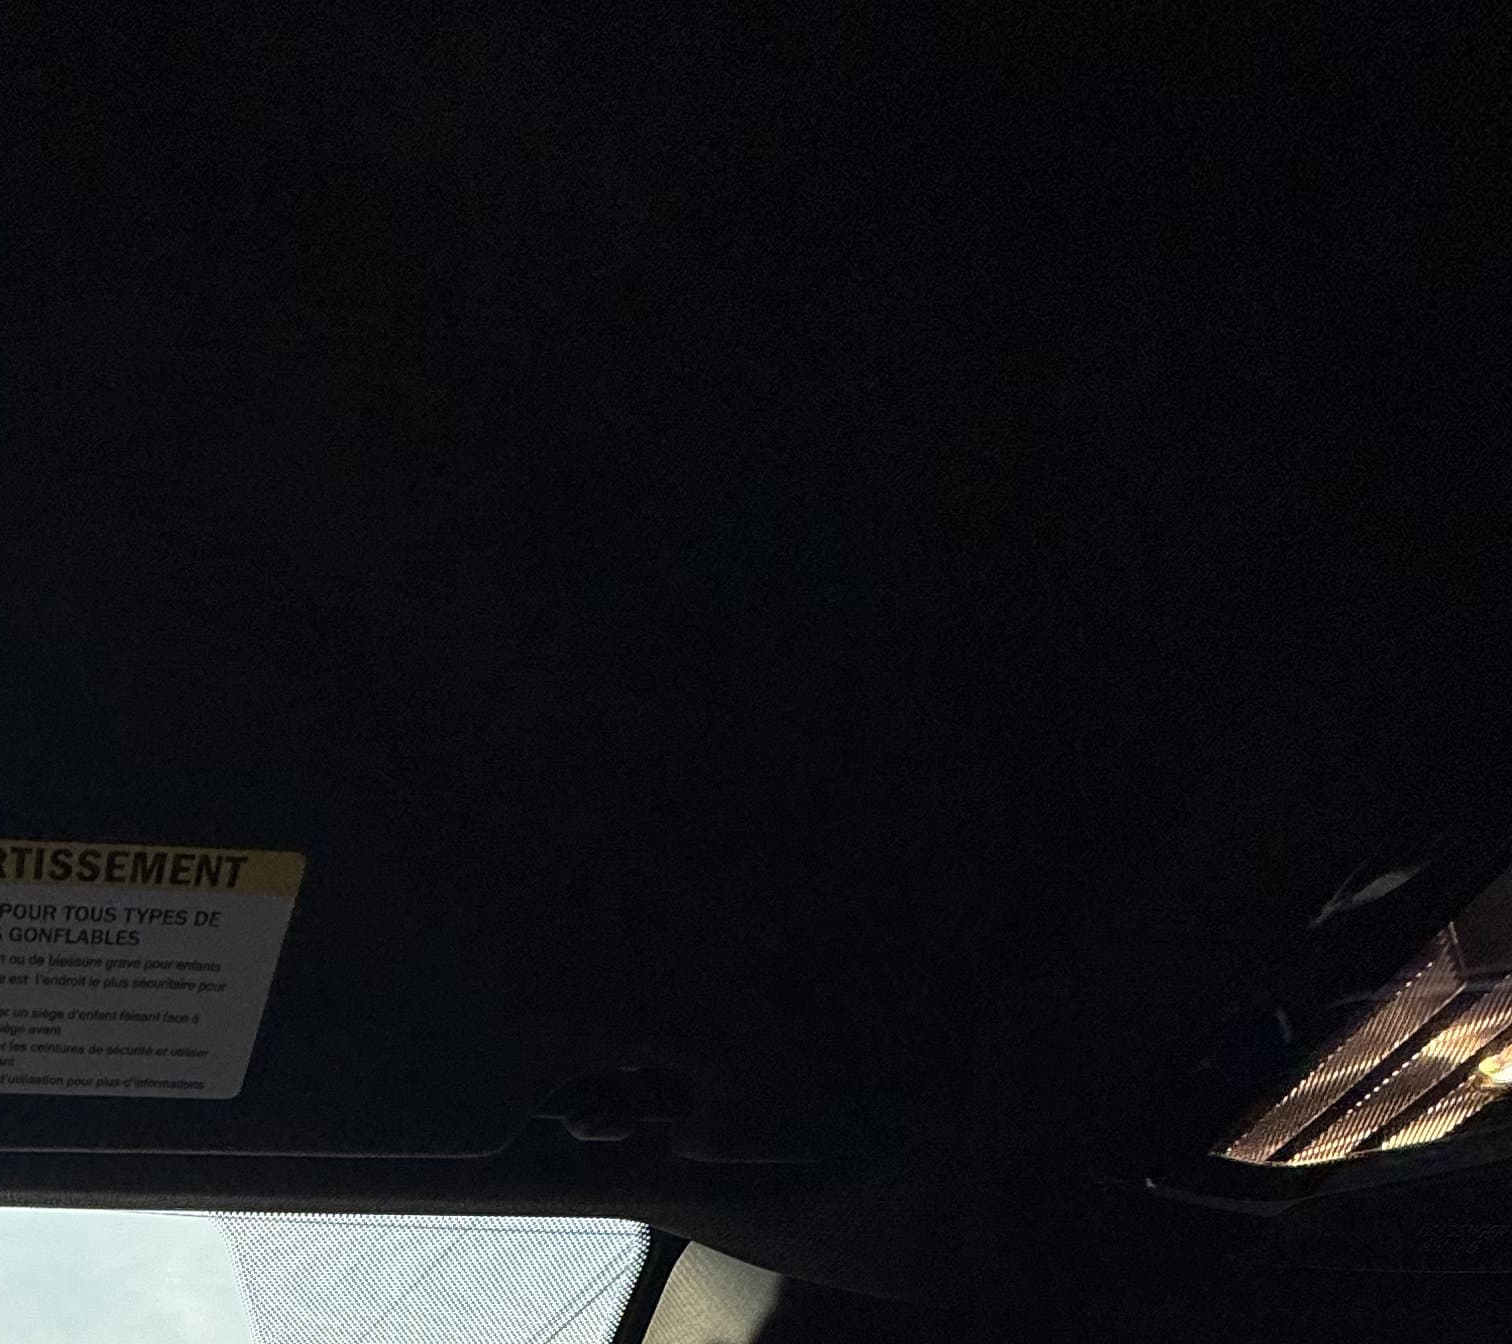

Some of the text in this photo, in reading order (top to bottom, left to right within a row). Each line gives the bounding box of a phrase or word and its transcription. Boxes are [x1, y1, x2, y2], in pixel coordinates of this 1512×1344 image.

[65, 904, 117, 922] TOUS
[124, 907, 188, 926] TYPES
[194, 911, 222, 927] DE
[9, 926, 141, 945] GONFLABLES
